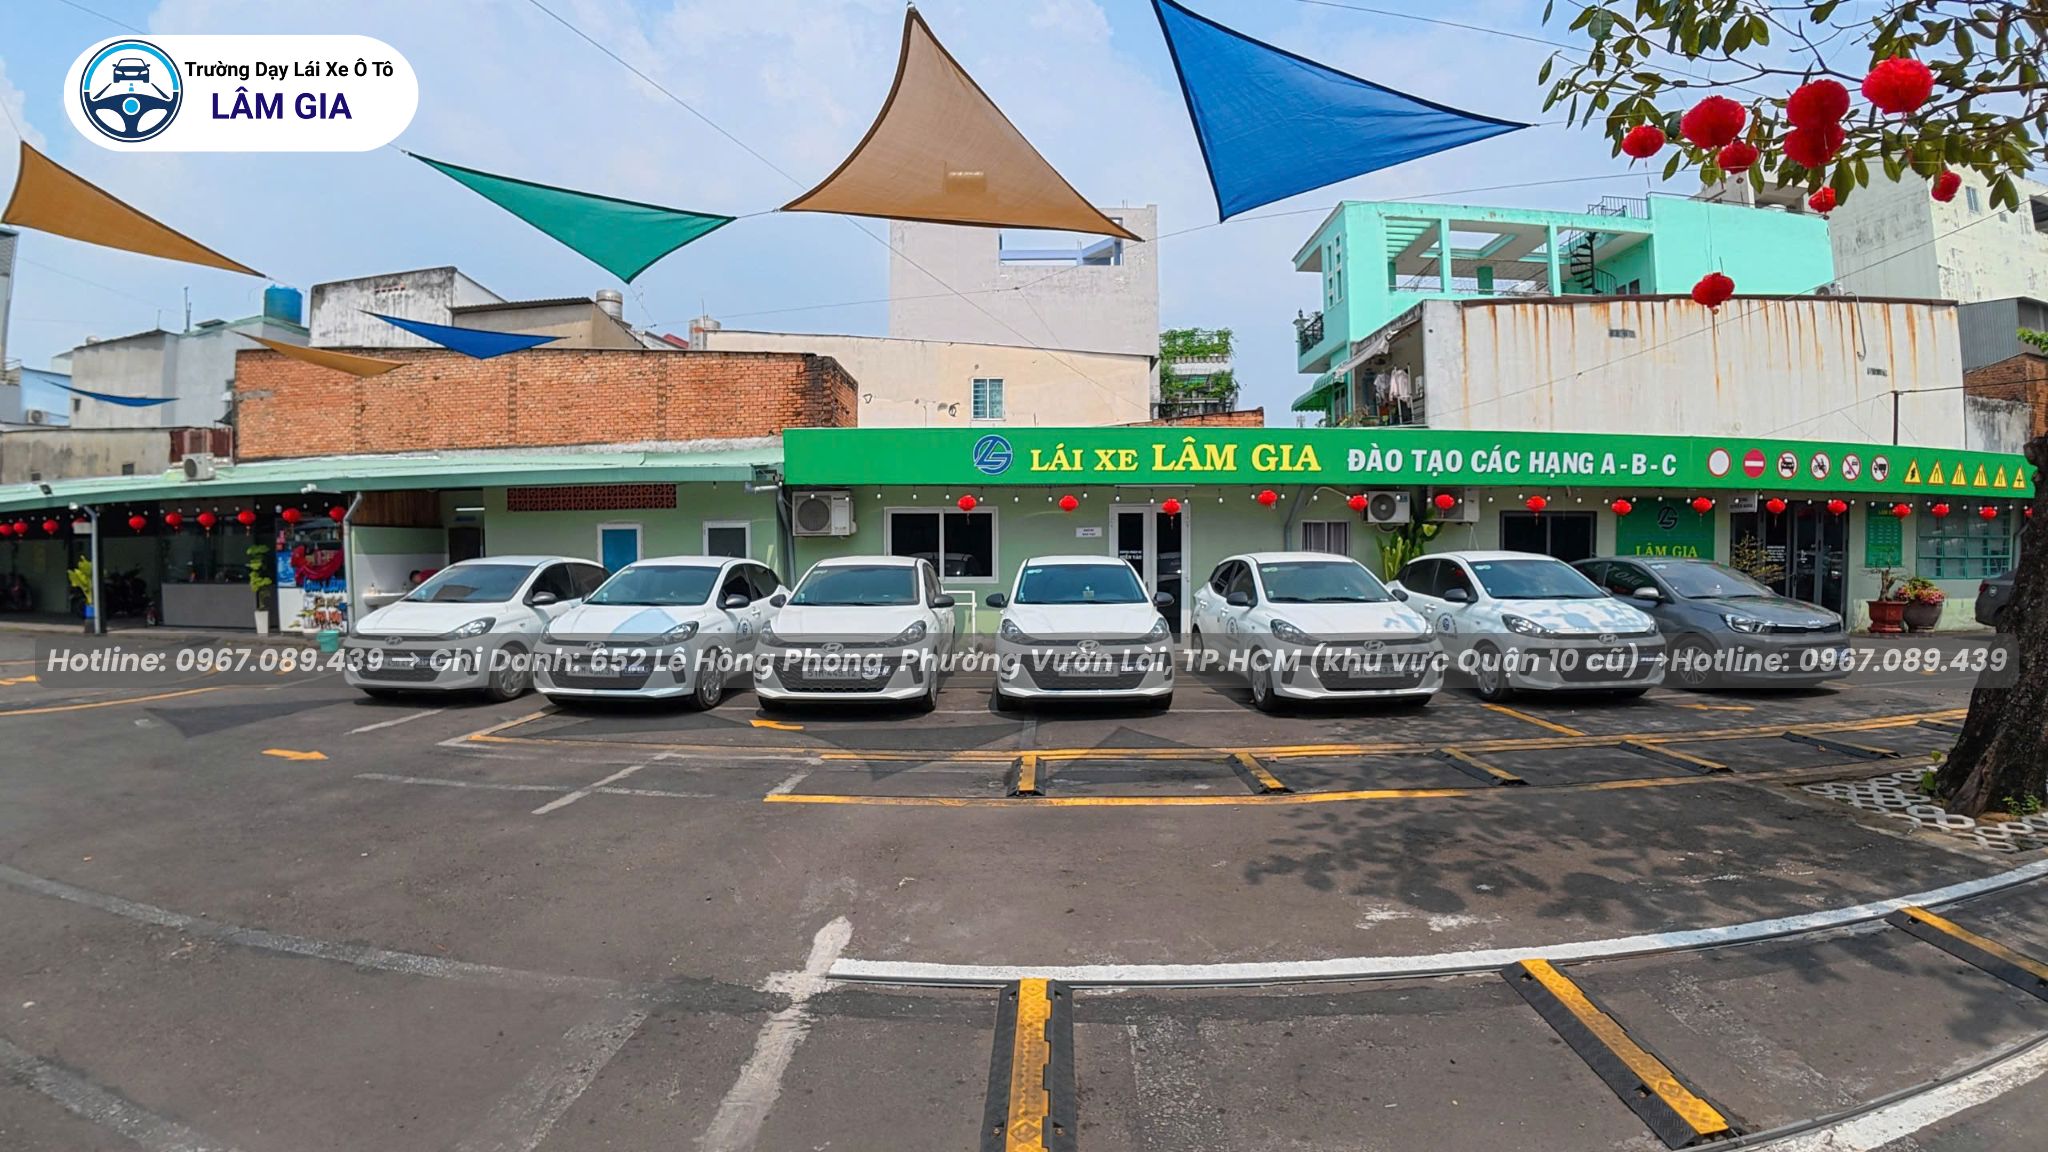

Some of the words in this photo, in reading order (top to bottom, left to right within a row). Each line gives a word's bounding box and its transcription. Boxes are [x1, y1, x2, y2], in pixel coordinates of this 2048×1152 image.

[1031, 443, 1083, 471] LÁI
[1095, 449, 1139, 471] XE
[1152, 437, 1238, 471] LÂM
[1252, 444, 1321, 471] GIA
[1347, 443, 1403, 472] ĐÀO
[1411, 449, 1464, 477] TẠO
[1471, 445, 1521, 473] CÁC
[1529, 451, 1594, 478] HẠNG
[1672, 545, 1698, 558] GIA
